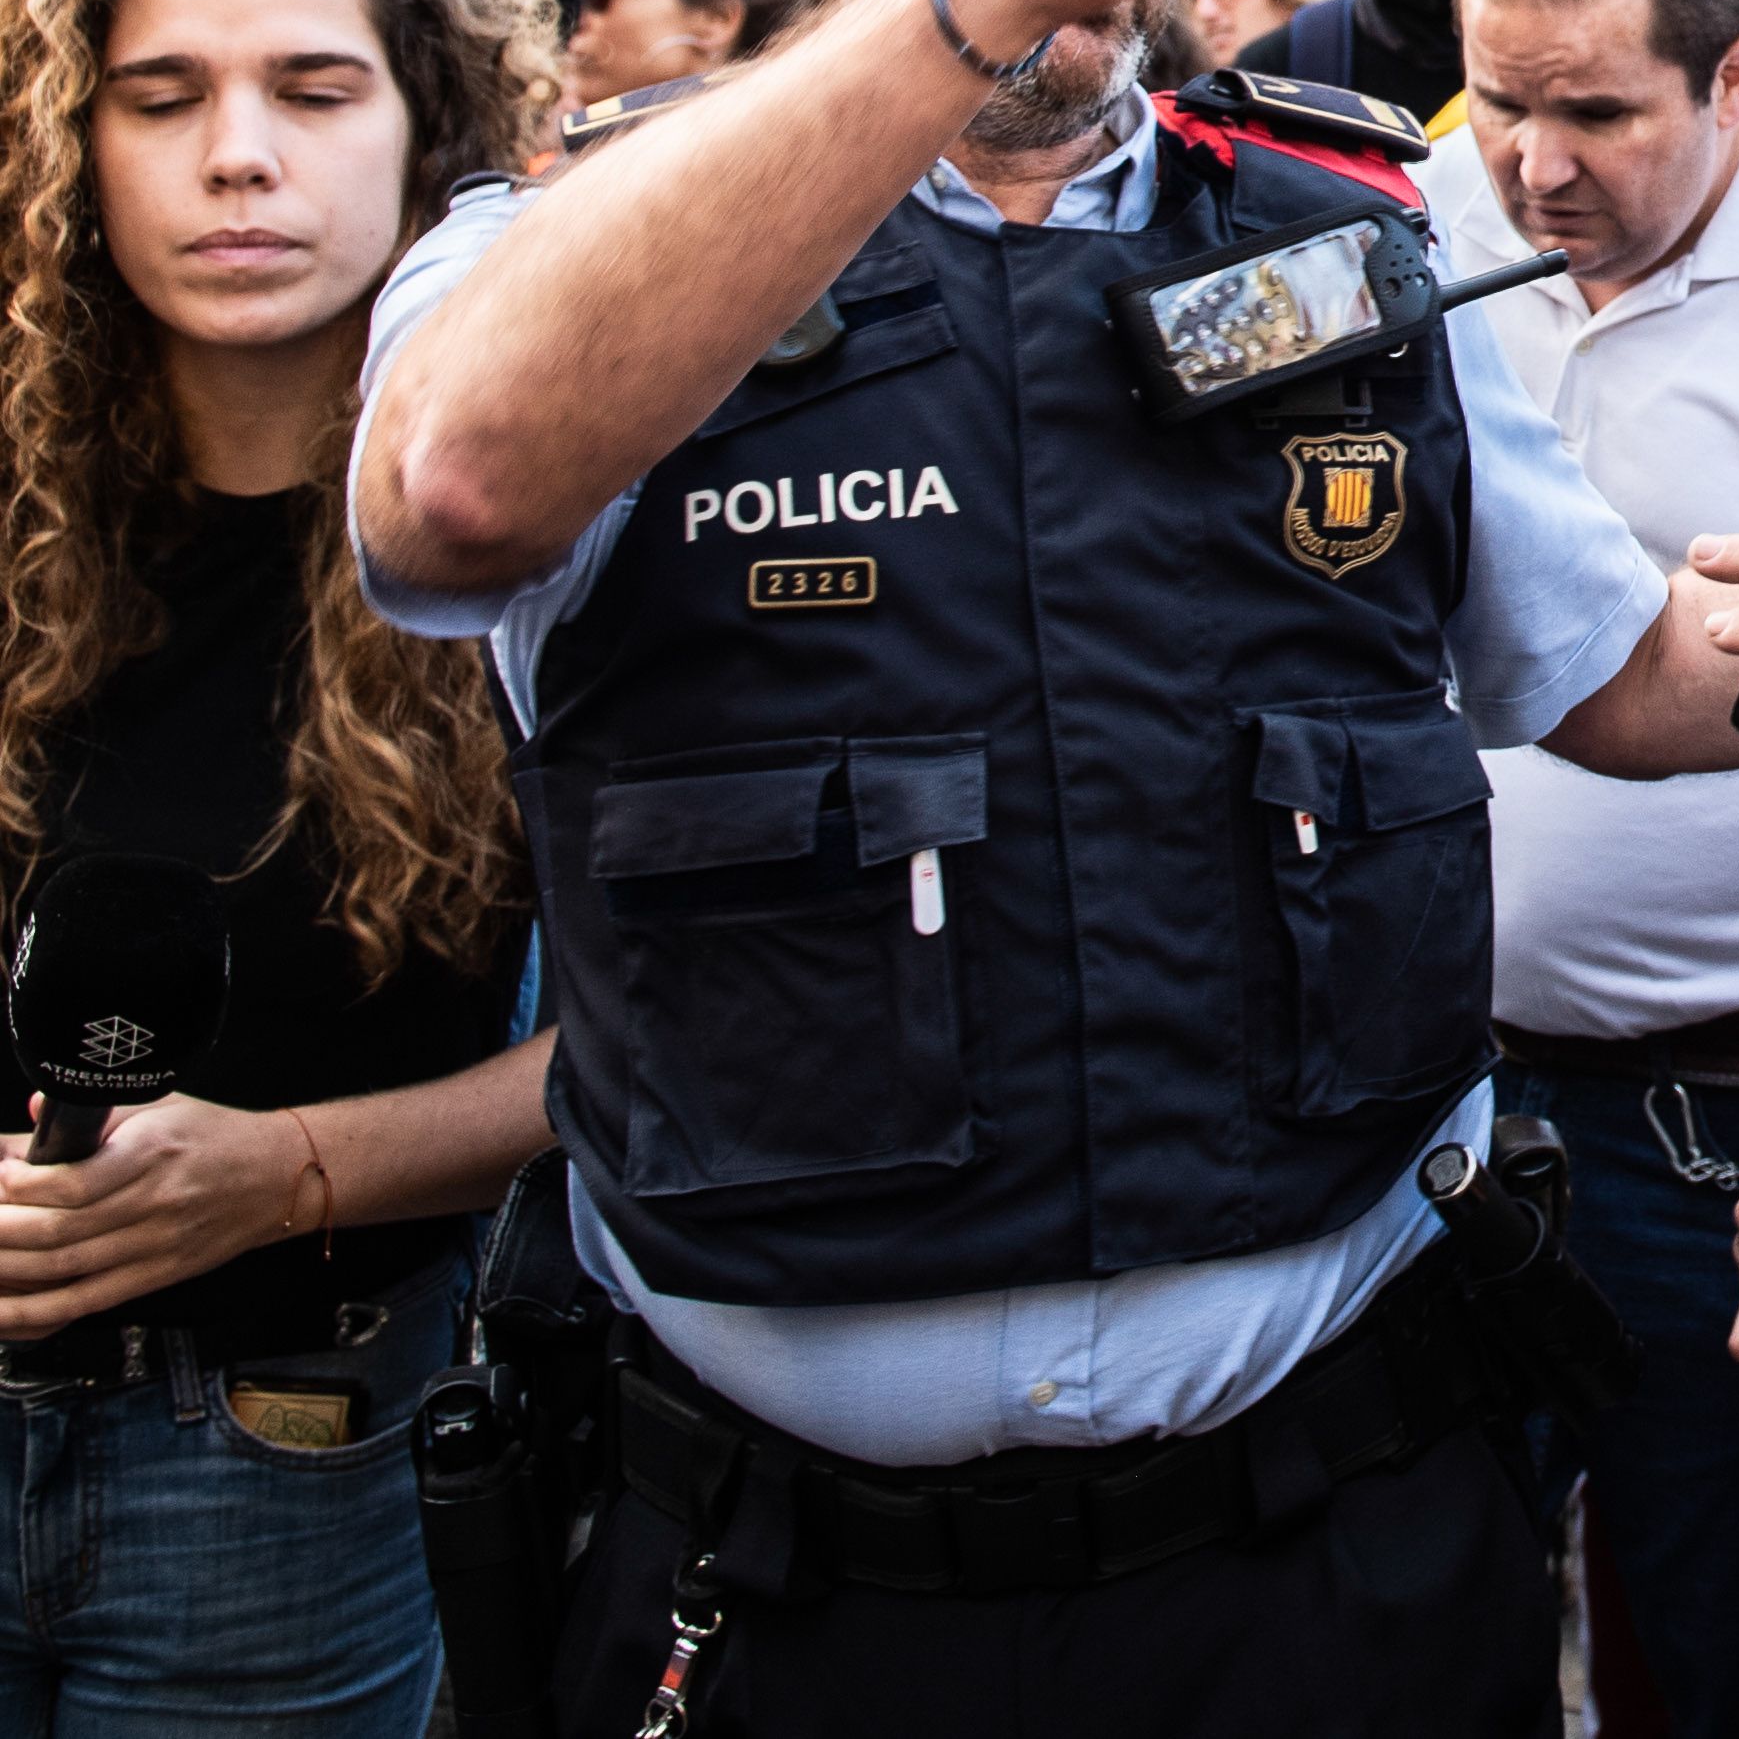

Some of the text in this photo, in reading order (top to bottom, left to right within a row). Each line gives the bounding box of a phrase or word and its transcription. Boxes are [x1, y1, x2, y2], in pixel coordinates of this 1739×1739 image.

[1301, 444, 1391, 462] POLICIA
[684, 465, 960, 543] POLICIA
[767, 570, 858, 596] 2326
[40, 1061, 176, 1082] ATRESMEDIA
[55, 1074, 159, 1089] TELEVISION
